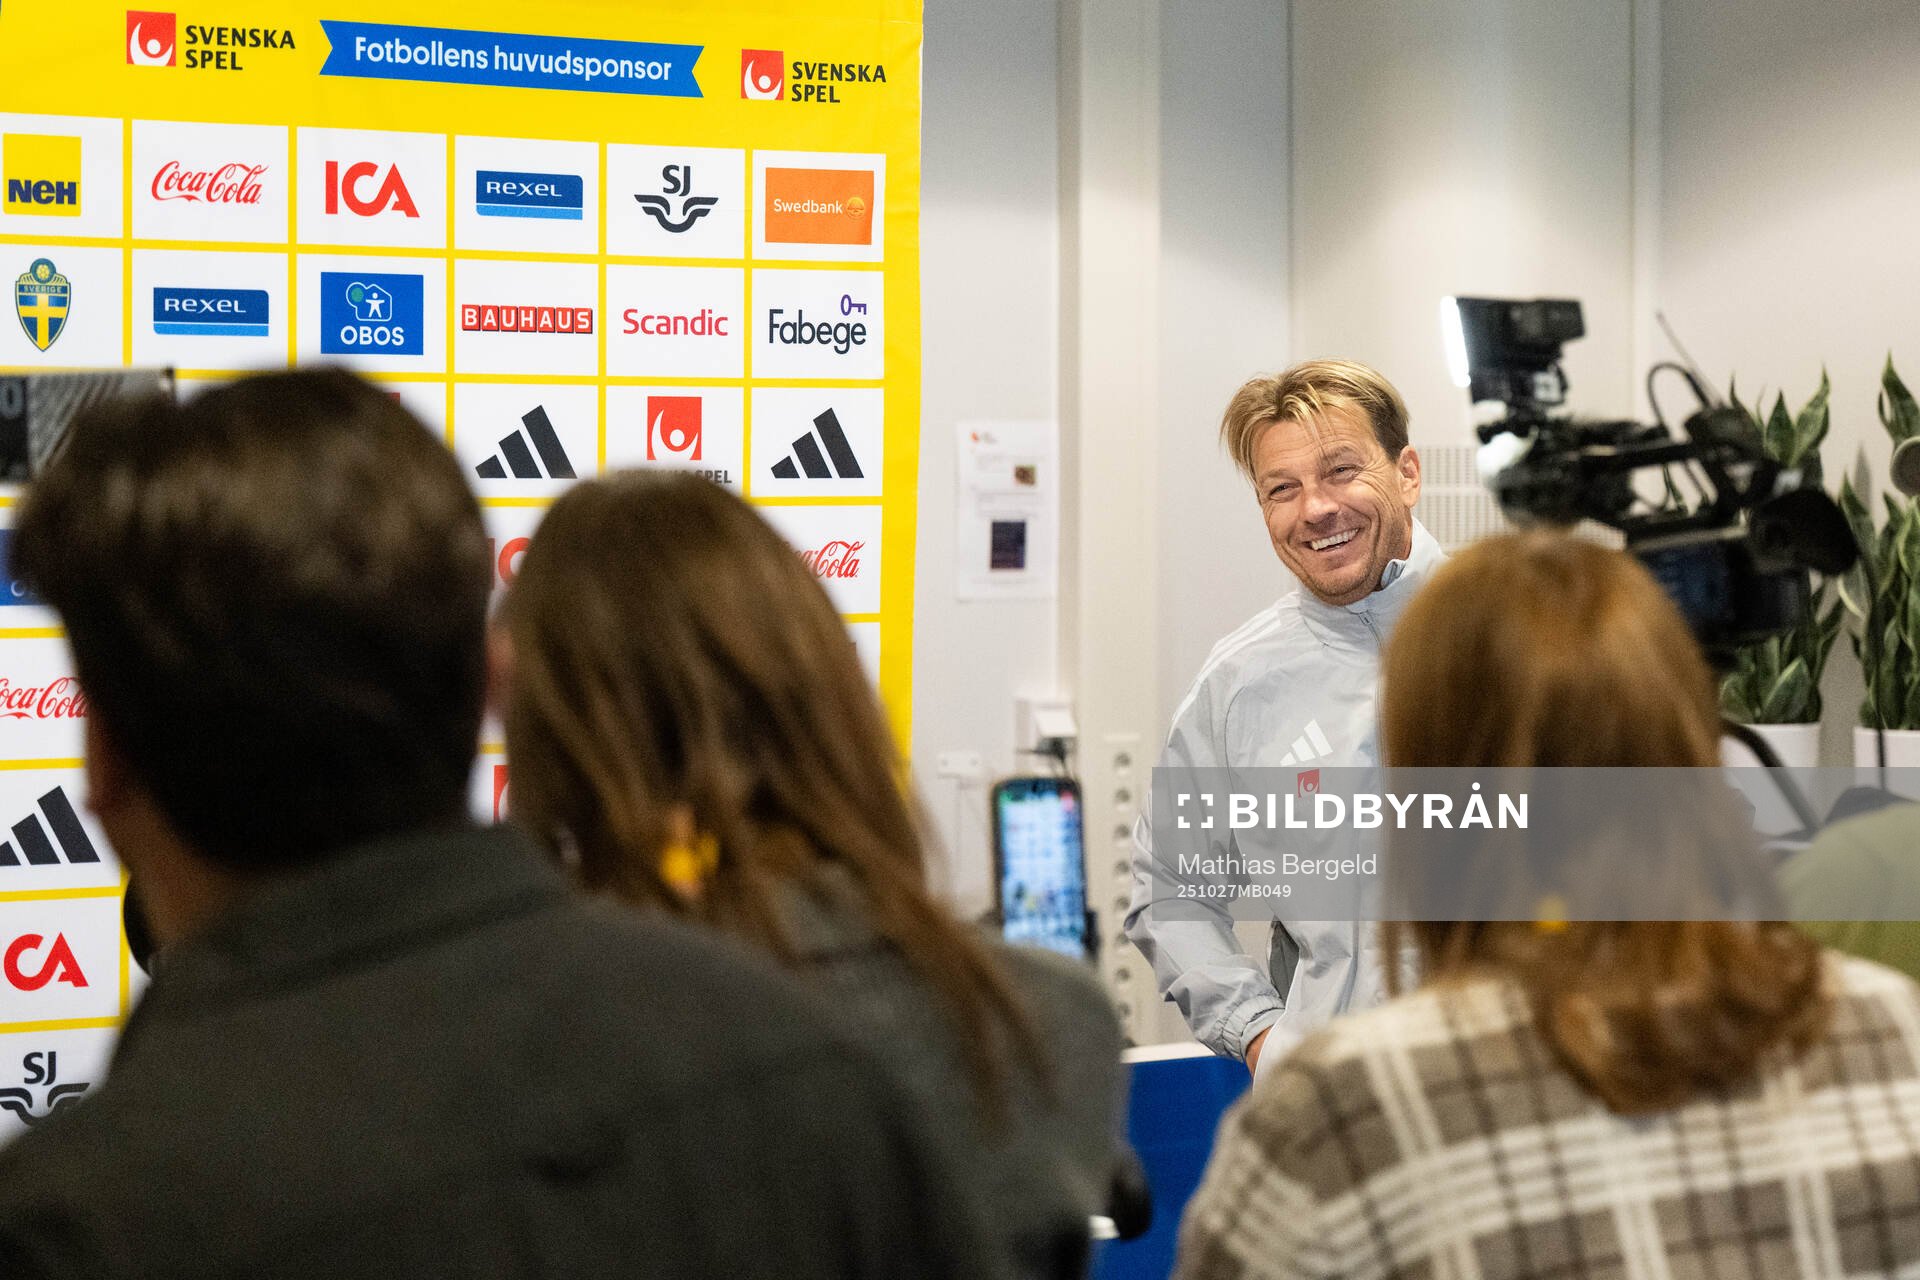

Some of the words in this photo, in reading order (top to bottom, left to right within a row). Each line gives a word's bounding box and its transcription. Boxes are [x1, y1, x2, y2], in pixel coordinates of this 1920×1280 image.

[186, 25, 296, 50] SVENSKA
[185, 50, 243, 71] SPEL
[354, 36, 488, 70] Fotbollens
[494, 45, 672, 82] huvudsponsor
[792, 61, 886, 83] SVENSKA
[791, 84, 840, 103] SPEL
[151, 160, 269, 205] Coca-Cola
[325, 160, 420, 218] ICA
[662, 164, 691, 197] SJ
[773, 198, 843, 214] Swedbank
[23, 284, 63, 294] SVERIGE
[464, 307, 590, 330] BAUHAUS
[622, 308, 729, 337] Scandic
[340, 325, 405, 347] OBOS
[768, 308, 867, 355] Fabege
[23, 1050, 57, 1087] SJ
